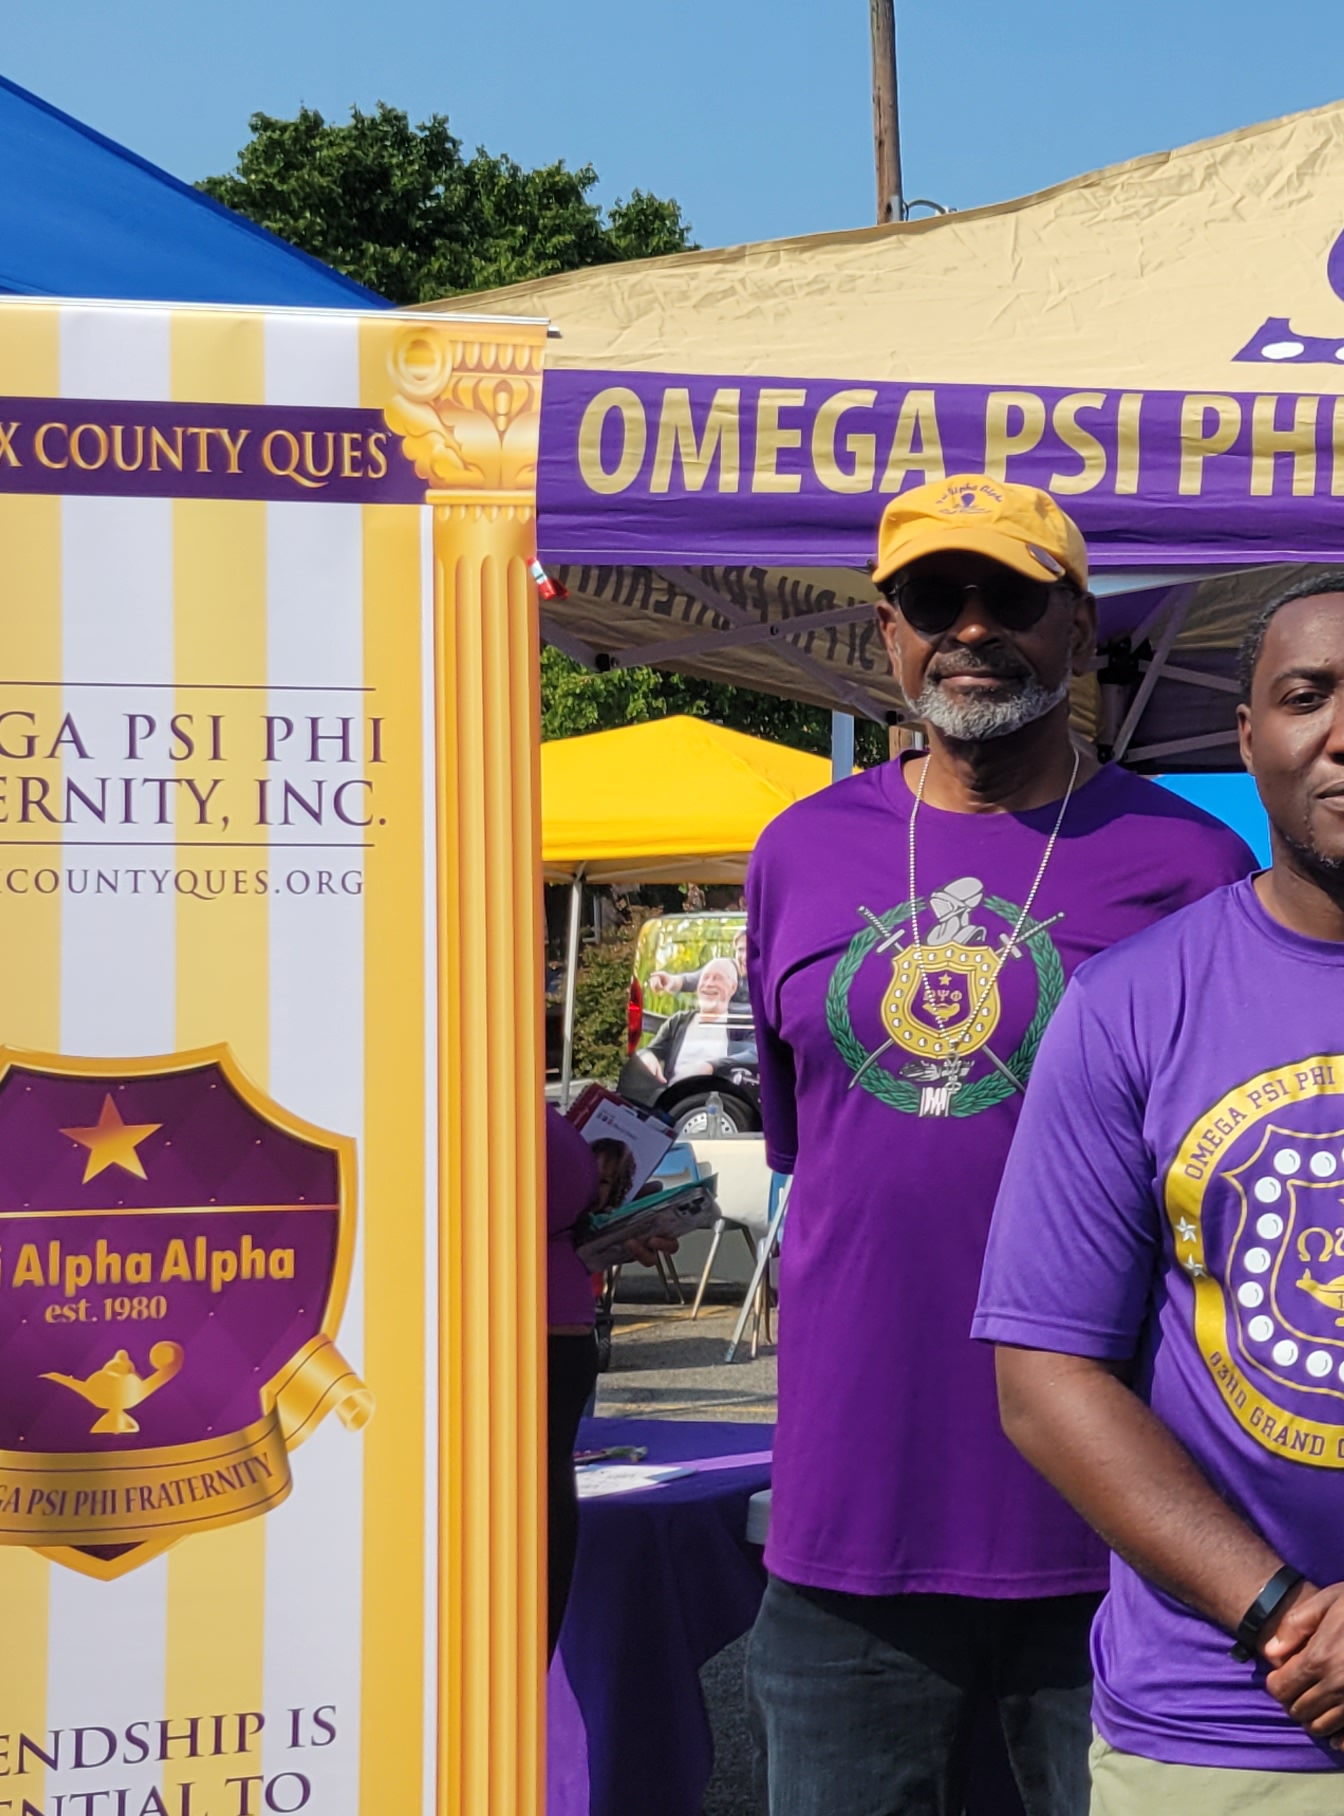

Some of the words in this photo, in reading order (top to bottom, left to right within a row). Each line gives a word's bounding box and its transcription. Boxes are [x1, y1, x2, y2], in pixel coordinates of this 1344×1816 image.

[34, 422, 252, 474] COUNTY
[261, 429, 389, 489] QUES
[577, 385, 947, 495] OMEGA
[985, 389, 1141, 497] PSI
[122, 713, 228, 761] PSI
[260, 714, 388, 763] PHI
[253, 778, 388, 827] INC.
[0, 867, 364, 900] COUNTYQUES.ORG
[1183, 1107, 1249, 1181] OMEGA
[1246, 1078, 1292, 1110] PSI
[1295, 1066, 1335, 1092] PHI
[12, 1239, 153, 1299] Alpha
[159, 1234, 295, 1293] Alpha
[44, 1299, 98, 1324] est.
[104, 1295, 168, 1322] 1980
[1248, 1410, 1326, 1458] GRAND
[26, 1487, 66, 1517] PSI
[73, 1488, 118, 1517] PHI
[124, 1452, 275, 1514] FRATERNITY
[286, 1704, 338, 1749] IS
[224, 1771, 312, 1816] TO
